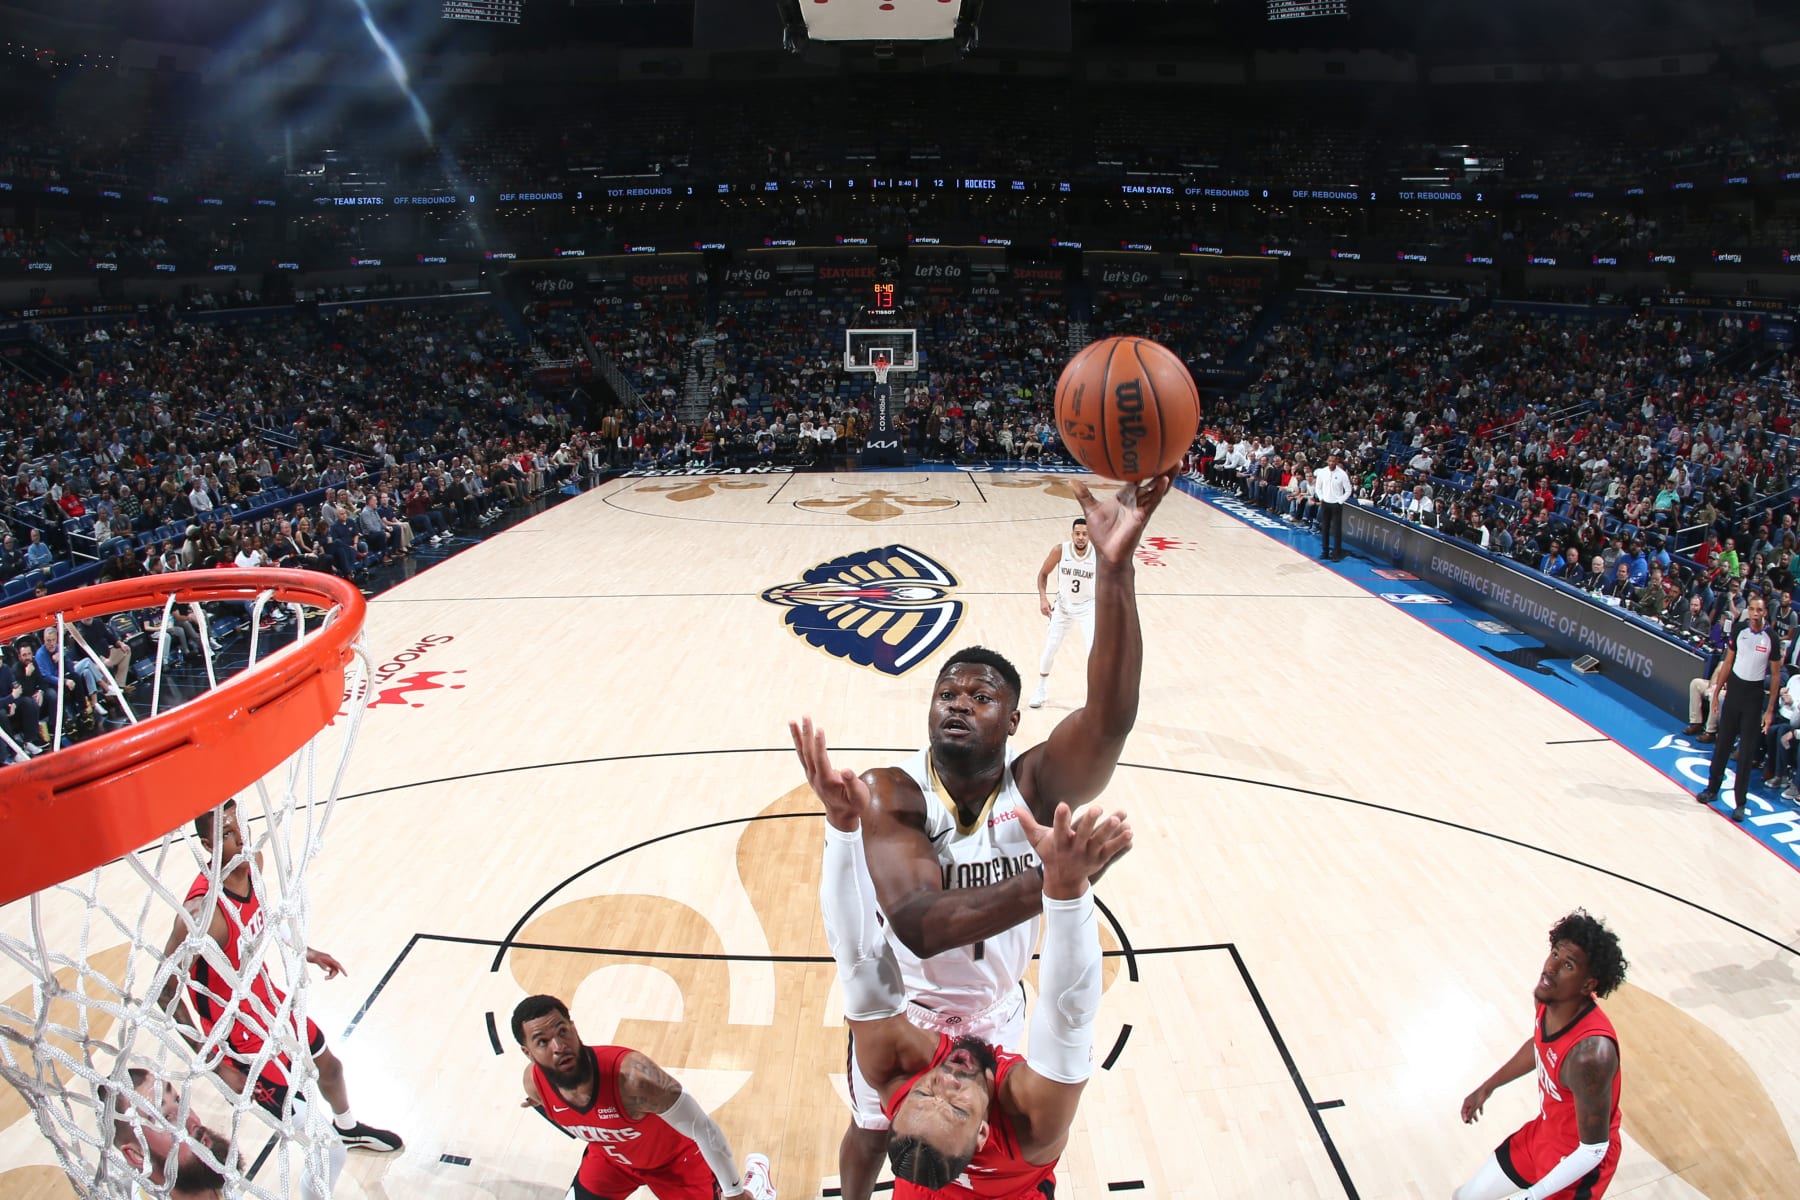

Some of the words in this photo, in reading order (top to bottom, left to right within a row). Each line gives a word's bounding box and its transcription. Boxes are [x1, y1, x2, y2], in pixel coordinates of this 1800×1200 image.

[848, 179, 854, 188] 9
[933, 179, 944, 187] 12
[964, 179, 996, 189] ROCKETS
[333, 197, 356, 205] TEAM
[357, 197, 384, 205] STATS:
[411, 195, 456, 204] REBOUNDS
[469, 195, 475, 203] 0
[499, 193, 517, 201] DEF.
[518, 192, 563, 200] REBOUNDS
[576, 191, 583, 199] 3
[607, 189, 625, 197] TOT.
[626, 187, 673, 196] REBOUNDS
[687, 187, 693, 195] 3
[1121, 185, 1145, 194] TEAM
[1146, 186, 1174, 195] STATS:
[1184, 187, 1203, 196] OFF.
[1204, 188, 1250, 197] REBOUNDS
[1262, 189, 1268, 198] 0
[1292, 190, 1310, 198] DEF.
[1311, 191, 1358, 200] REBOUNDS
[1370, 192, 1377, 201] 2
[1399, 192, 1416, 200] TOT.
[1417, 192, 1462, 200] REBOUNDS
[1476, 193, 1483, 201] 2
[772, 239, 796, 248] entergy
[844, 237, 868, 246] entergy
[916, 236, 940, 244] entergy
[987, 237, 1012, 246] entergy
[632, 246, 656, 254] entergy
[702, 242, 726, 252] entergy
[1058, 241, 1082, 250] entergy
[1128, 243, 1152, 252] entergy
[1198, 246, 1222, 254] entergy
[493, 252, 516, 260] entergy
[561, 249, 584, 258] entergy
[1268, 248, 1292, 258] entergy
[1338, 251, 1360, 260] entergy
[1404, 253, 1426, 262] entergy
[358, 258, 382, 268] entergy
[424, 256, 446, 264] entergy
[1654, 255, 1676, 264] entergy
[1718, 254, 1742, 264] entergy
[754, 268, 770, 281] Go
[818, 266, 877, 279] SEATGEEK
[914, 264, 943, 277] Let's
[944, 265, 961, 277] Go
[632, 272, 688, 288] SEATGEEK
[1103, 270, 1130, 282] Let's
[1132, 271, 1148, 283] Go
[531, 278, 557, 292] et's
[559, 278, 574, 291] Go
[874, 283, 894, 293] 8:40
[785, 287, 801, 296] Let's
[801, 288, 813, 297] Go
[971, 287, 989, 295] Let's
[989, 287, 1000, 295] Go
[611, 296, 622, 305] Go
[876, 292, 892, 308] 13
[1115, 376, 1148, 474] Wilson
[619, 465, 796, 477] PELICANS
[1346, 515, 1391, 548] SHIFT
[1071, 579, 1081, 593] 3
[1431, 555, 1488, 595] EXPERIENCE
[1491, 581, 1512, 606] THE
[1512, 589, 1557, 629] FUTURE
[1558, 615, 1578, 638] OF
[1578, 625, 1654, 678] PAYMENTS
[375, 634, 455, 684] SMOOT
[597, 1105, 617, 1113] credit
[602, 1145, 633, 1165] 5
